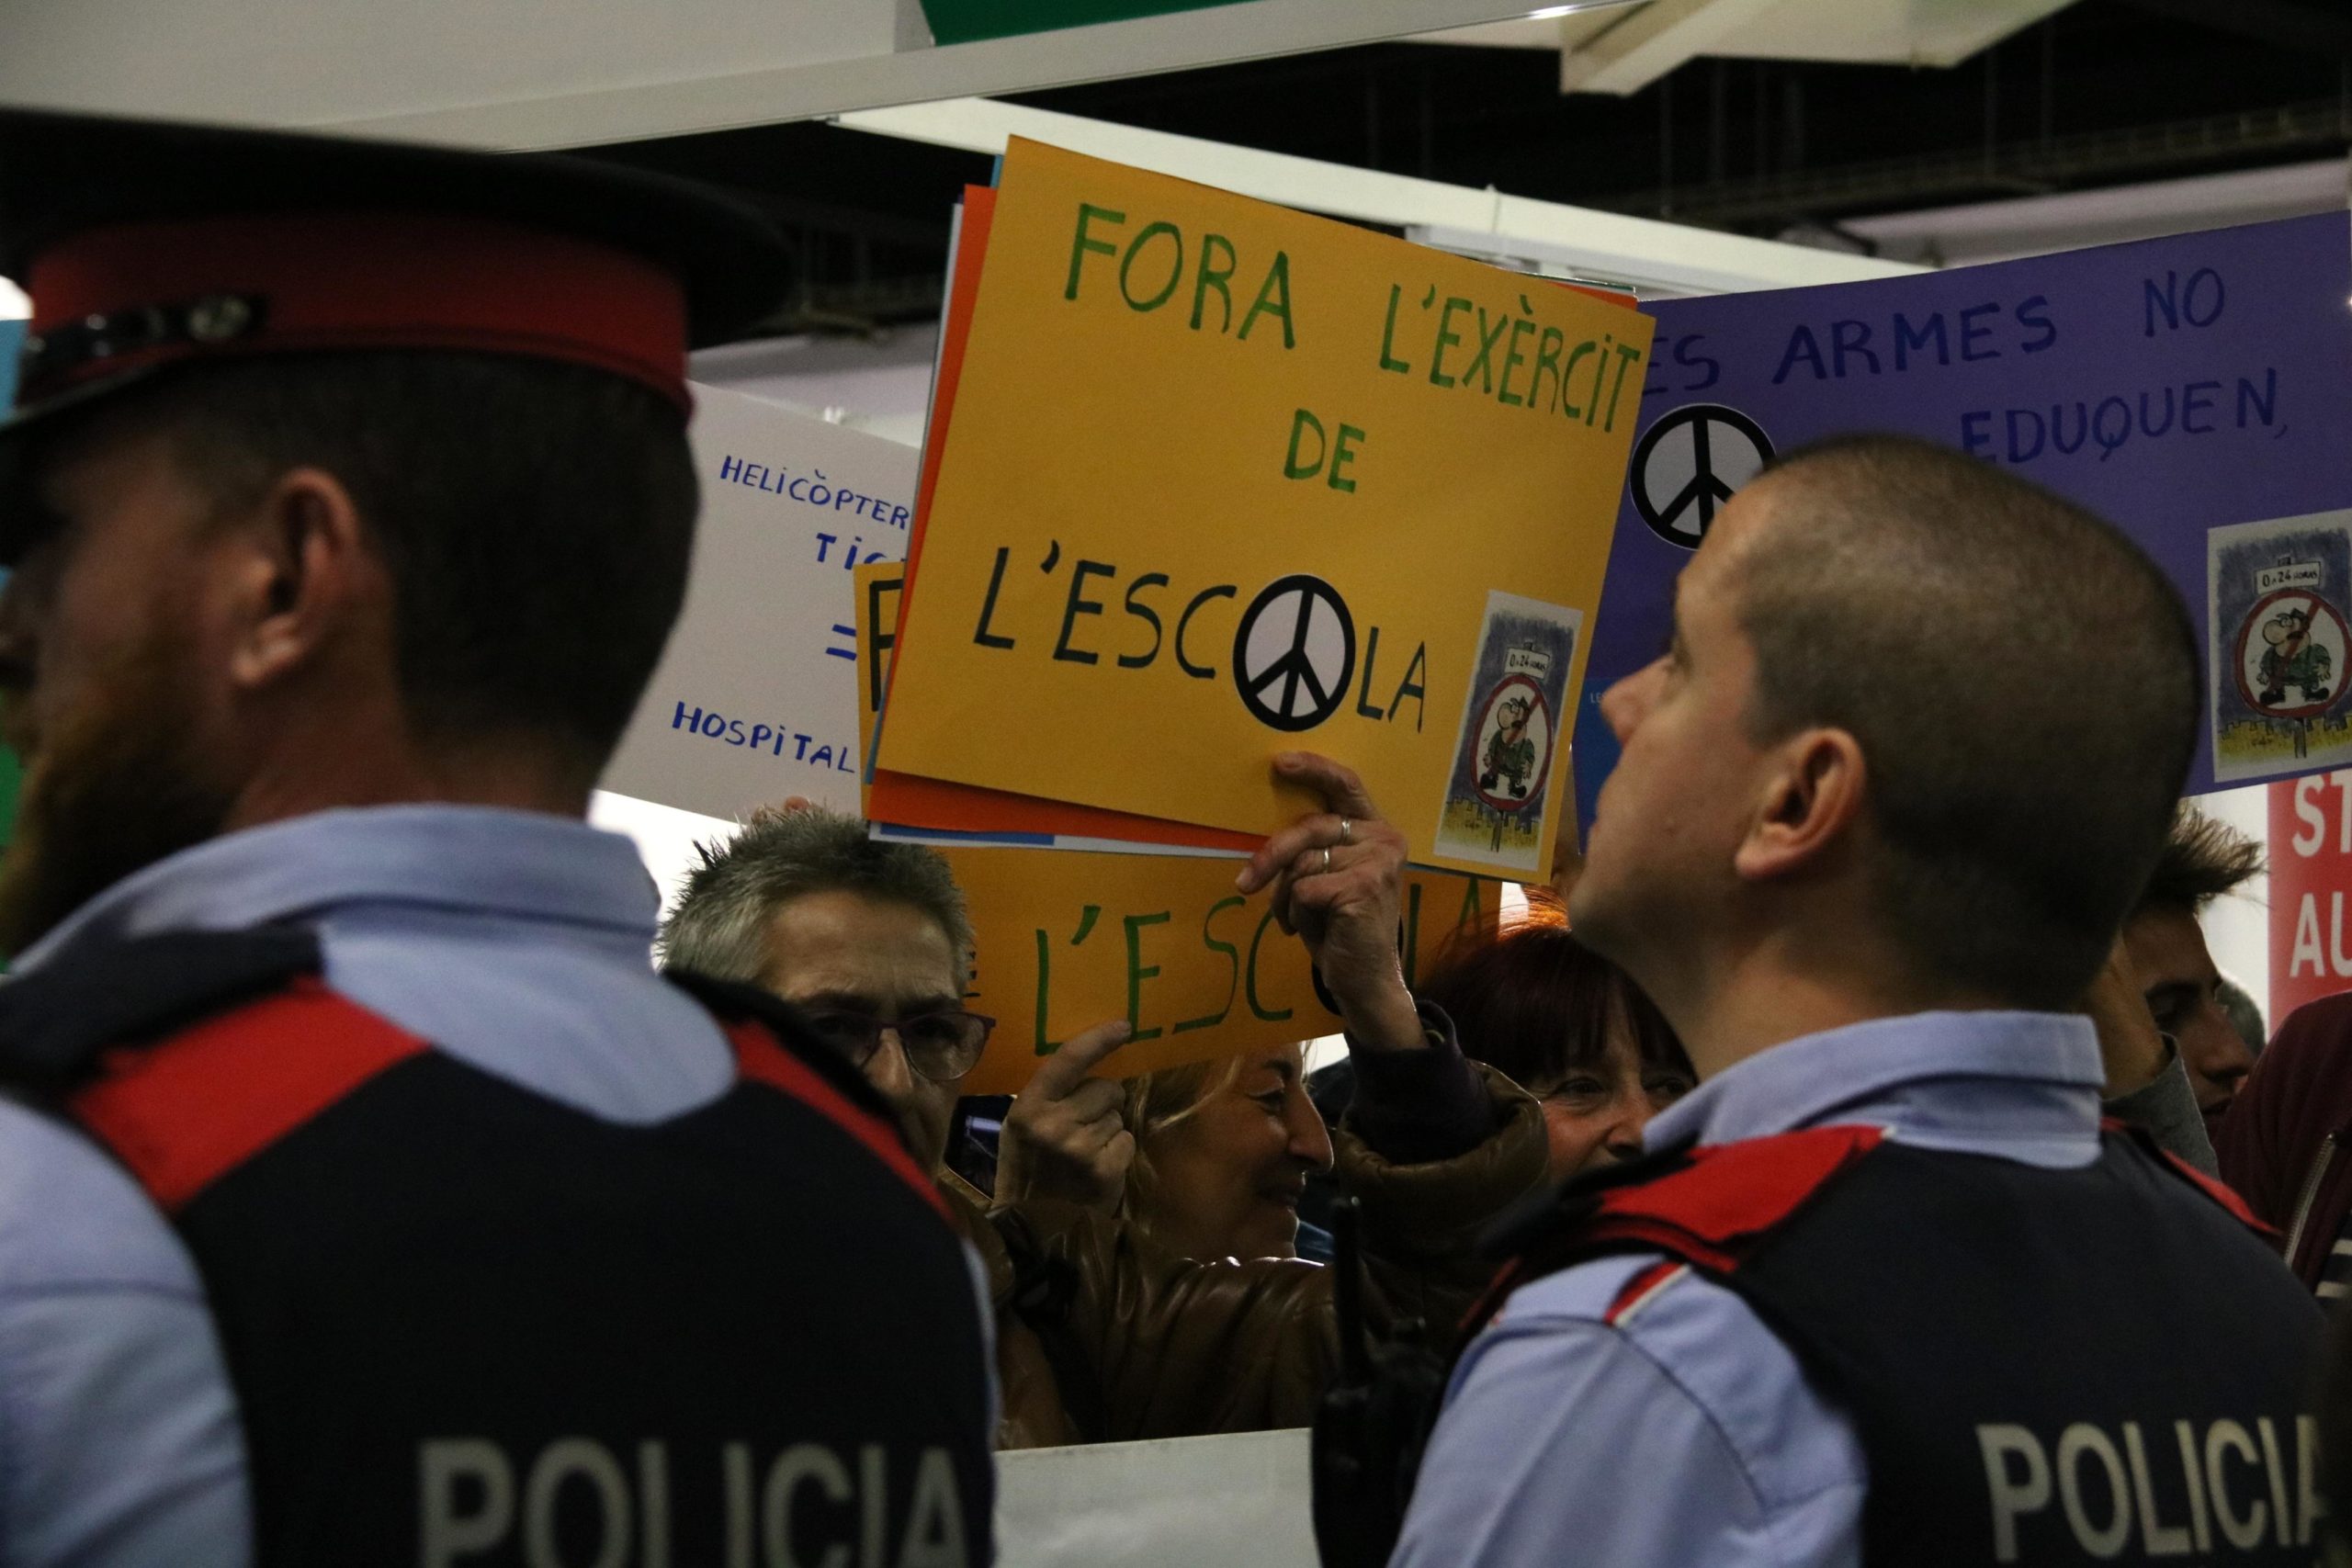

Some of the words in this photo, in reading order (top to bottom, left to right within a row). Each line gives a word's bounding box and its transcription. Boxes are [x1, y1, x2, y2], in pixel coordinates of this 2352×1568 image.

[1064, 202, 1295, 349] FORA
[1771, 294, 2057, 384] ARMES
[2143, 266, 2226, 337] NO
[1284, 408, 1366, 493] DE
[1960, 367, 2290, 462] EDUQUEN,
[419, 1434, 969, 1568] POLICIA
[1973, 1413, 2331, 1563] POLICIA
